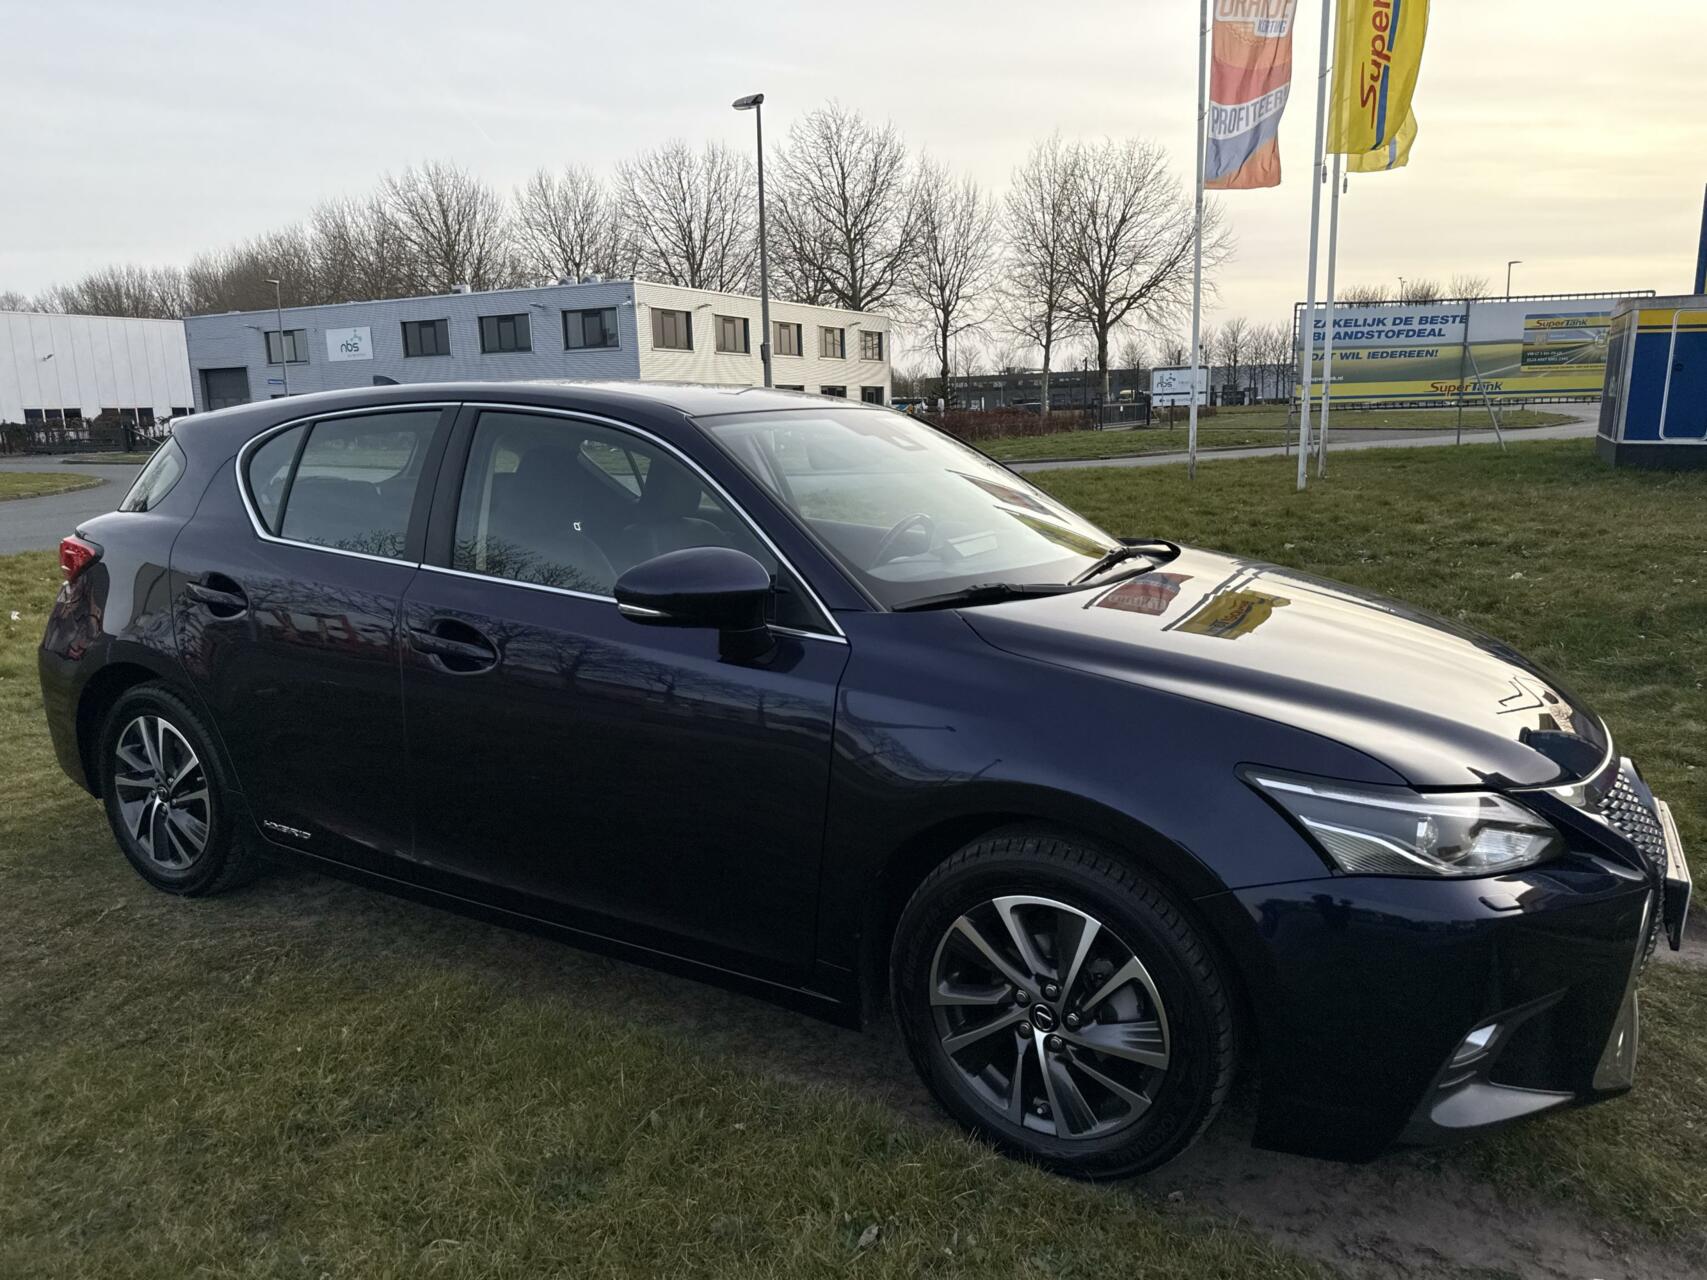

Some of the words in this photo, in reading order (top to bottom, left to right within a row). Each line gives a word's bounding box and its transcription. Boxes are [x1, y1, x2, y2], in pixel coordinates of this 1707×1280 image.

[1392, 316, 1415, 326] DE
[1418, 314, 1470, 326] BESTE
[340, 340, 360, 353] nbs
[1340, 352, 1363, 361] WIL
[1367, 349, 1439, 360] IEDEREEN!
